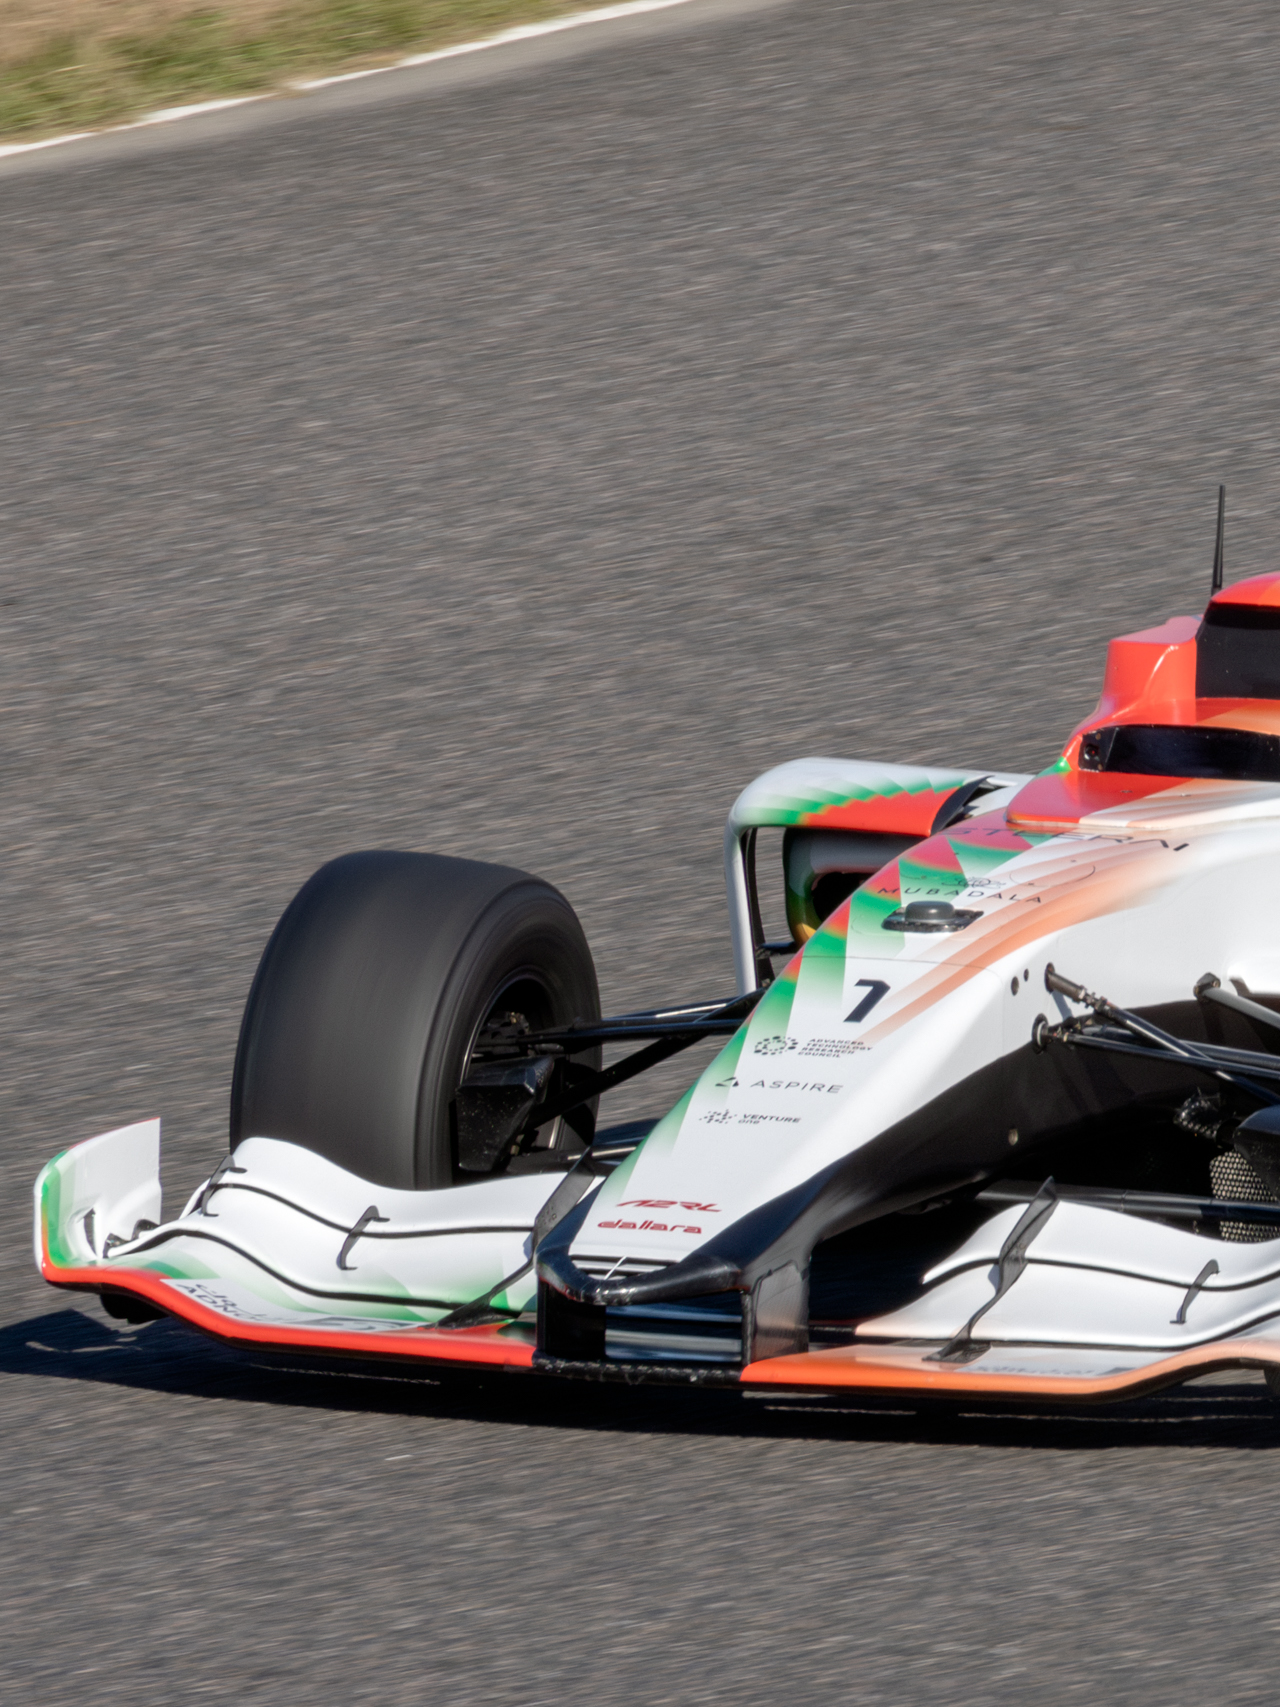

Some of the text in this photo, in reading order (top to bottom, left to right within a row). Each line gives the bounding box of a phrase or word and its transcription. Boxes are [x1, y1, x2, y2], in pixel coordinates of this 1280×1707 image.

[877, 885, 1042, 904] MUBADALA
[750, 1079, 844, 1094] ASPIRE
[743, 1113, 801, 1124] VENTURE
[597, 1218, 702, 1234] dallara
